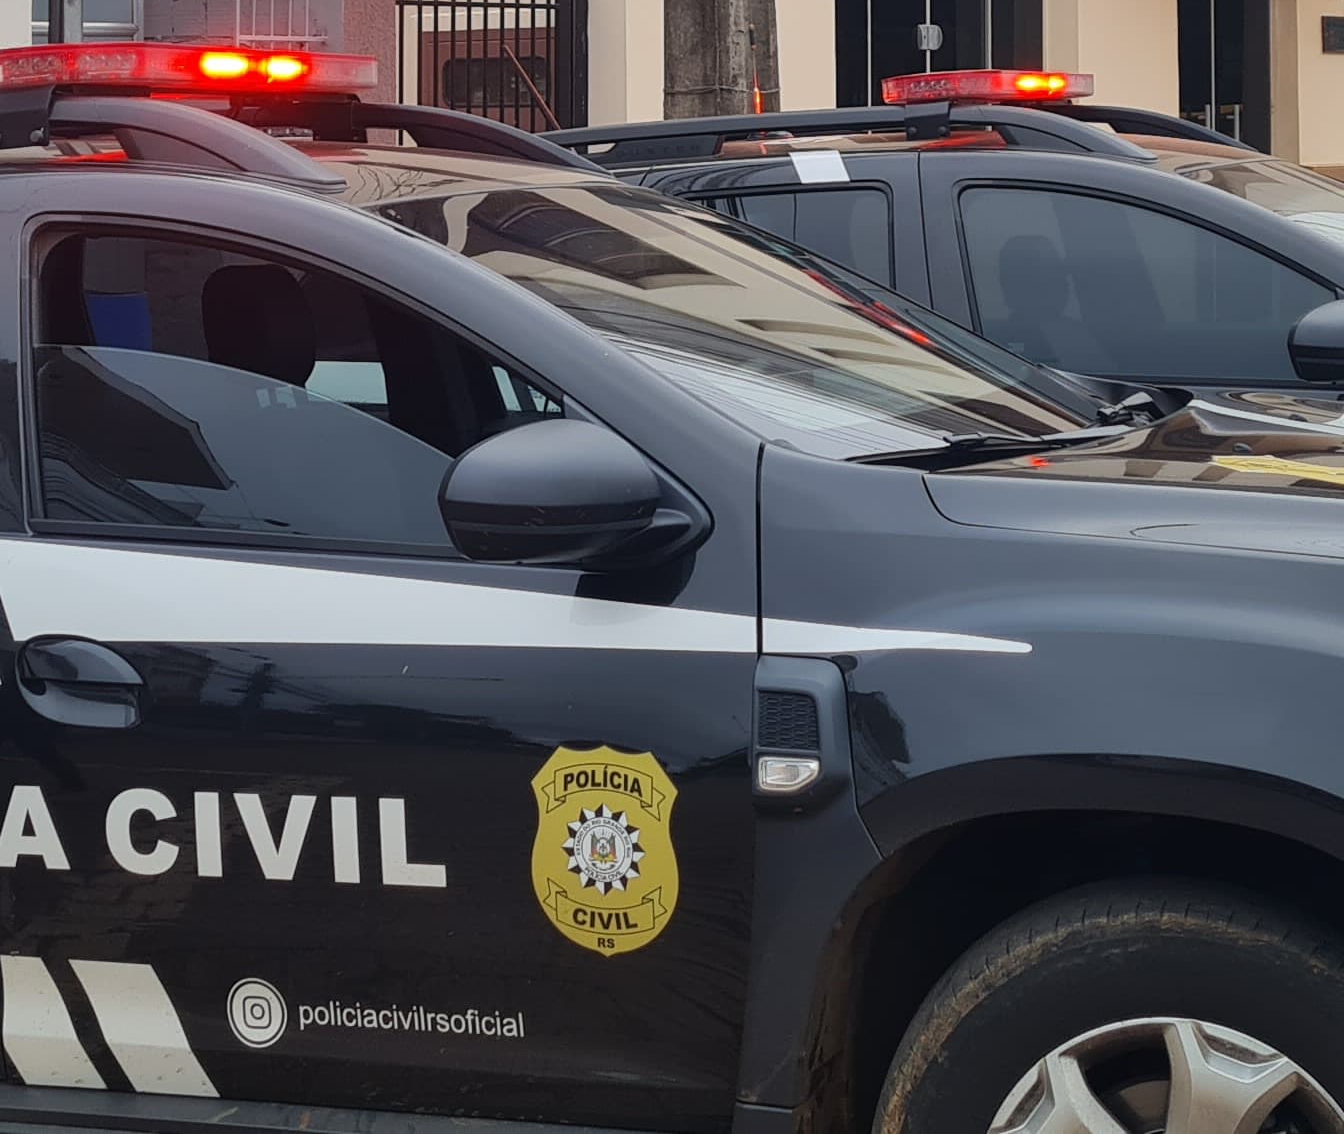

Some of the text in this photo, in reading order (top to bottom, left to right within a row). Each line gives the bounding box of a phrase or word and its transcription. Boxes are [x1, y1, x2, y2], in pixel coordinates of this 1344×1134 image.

[562, 765, 643, 797] POLÍCIA
[104, 787, 448, 888] CIVIL
[573, 908, 638, 930] CIVIL
[597, 937, 615, 949] RS
[299, 1000, 526, 1038] policiacivilrsoficial
